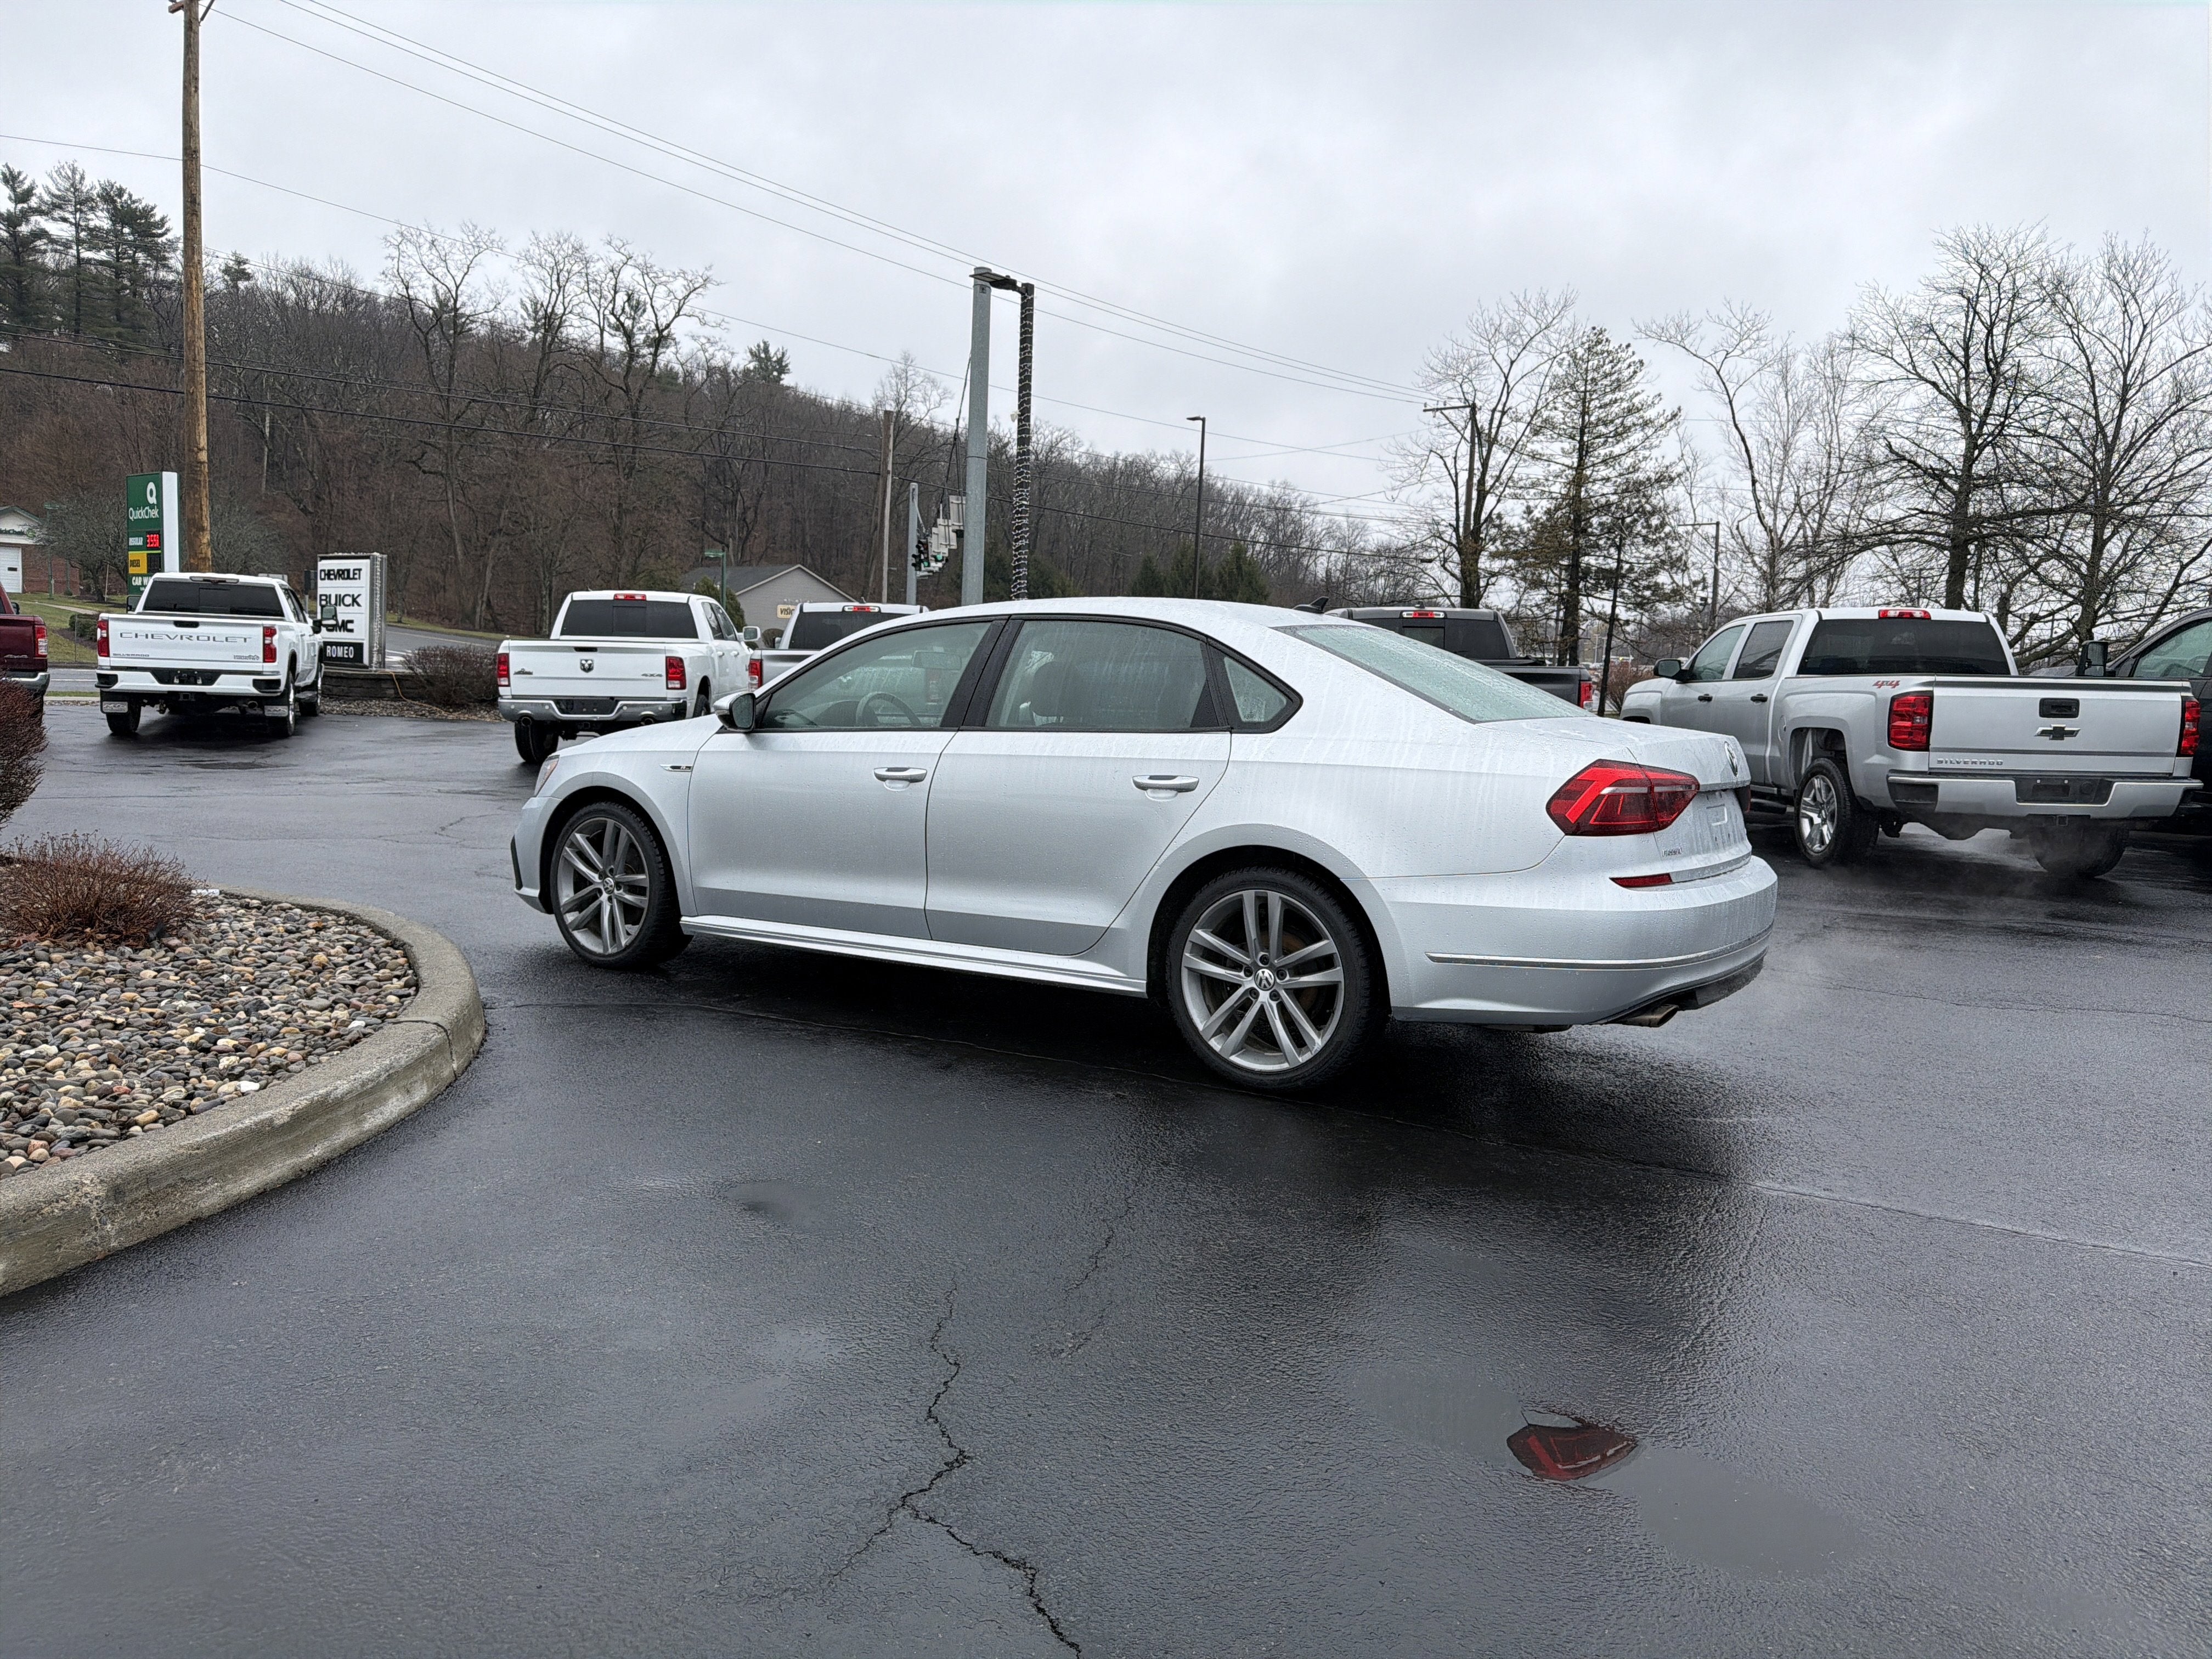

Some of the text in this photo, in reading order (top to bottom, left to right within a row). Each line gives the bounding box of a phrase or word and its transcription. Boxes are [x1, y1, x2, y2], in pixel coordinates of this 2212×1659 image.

[146, 482, 156, 504] Q
[128, 505, 159, 521] QuickChek
[129, 537, 143, 546] REGULAR
[129, 559, 140, 567] DIESEL
[319, 568, 362, 580] CHEVROLET
[132, 577, 142, 586] CAR
[319, 594, 362, 607] BUICK
[325, 619, 354, 633] MC
[120, 632, 252, 643] CHEVROLET
[326, 646, 354, 658] ROMEO
